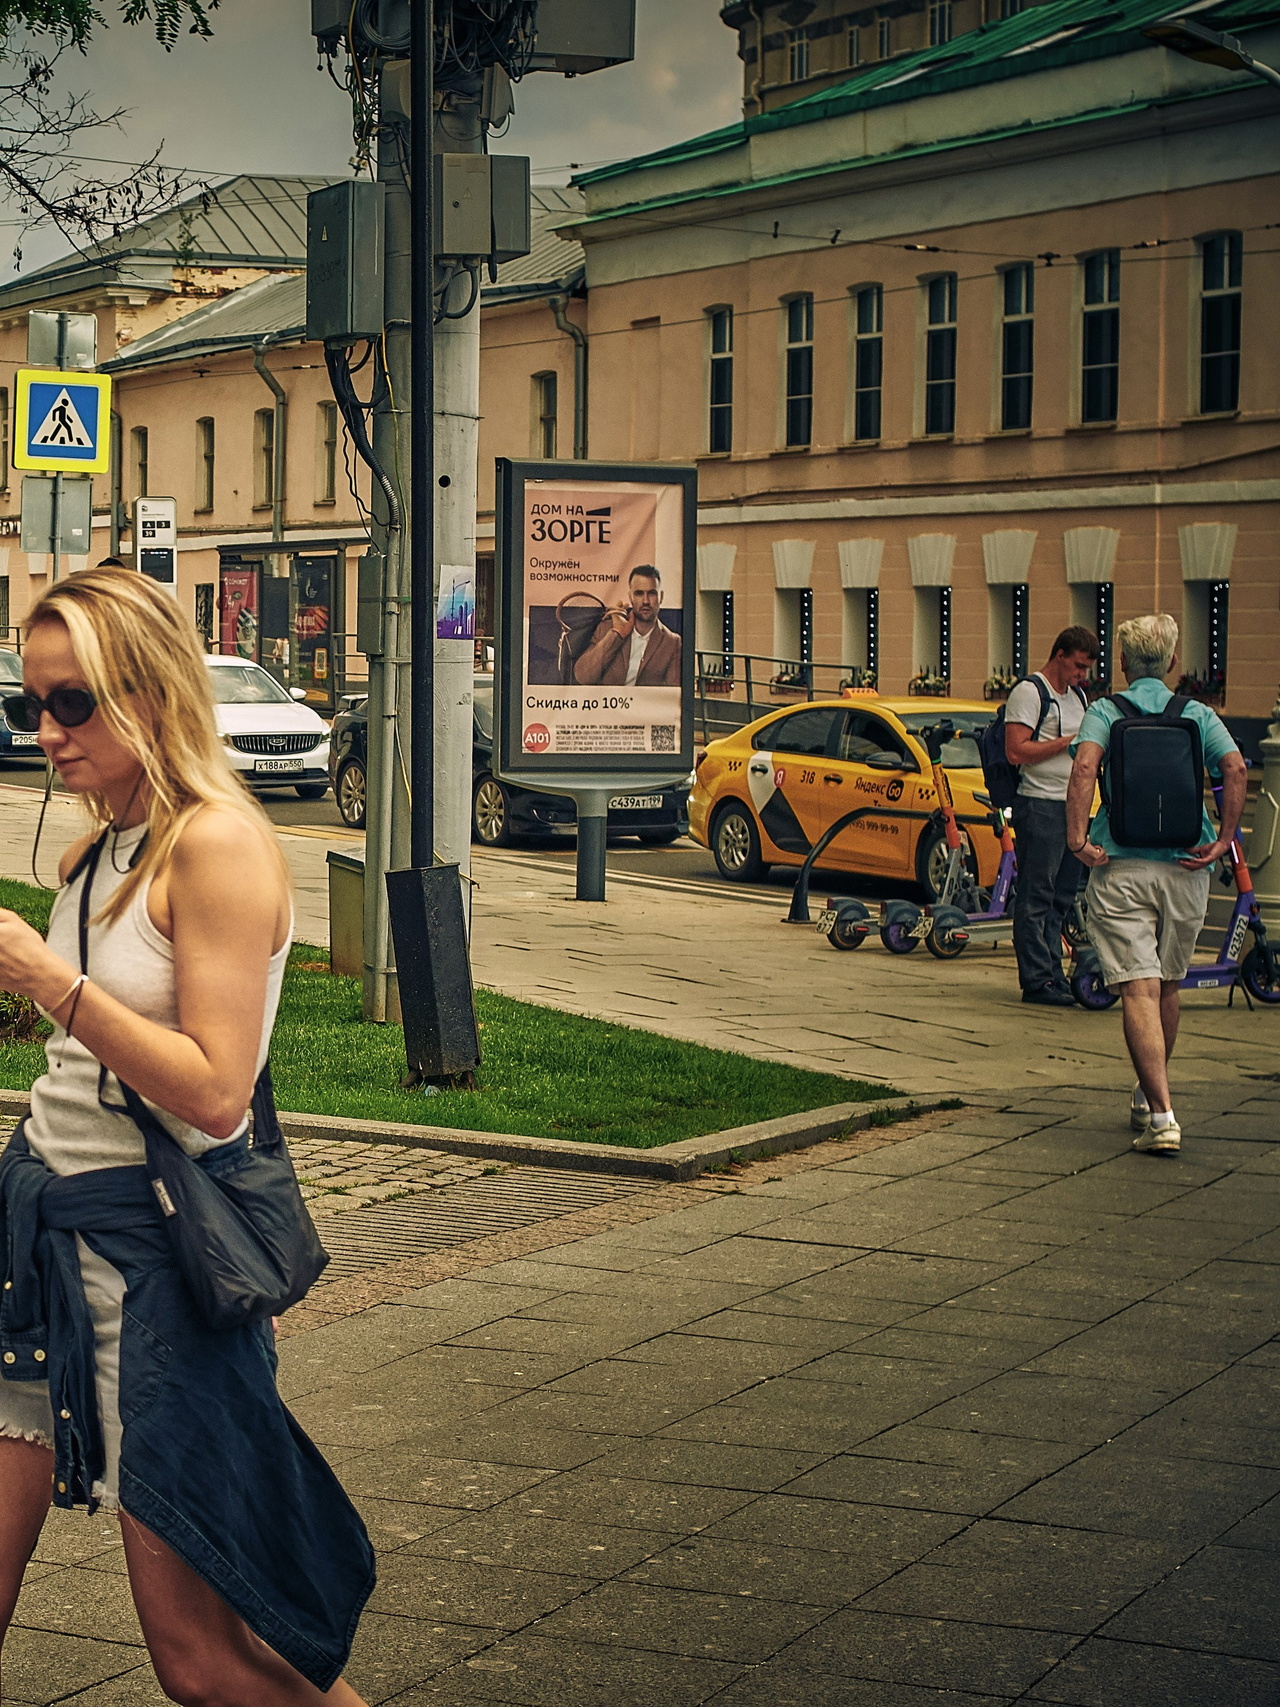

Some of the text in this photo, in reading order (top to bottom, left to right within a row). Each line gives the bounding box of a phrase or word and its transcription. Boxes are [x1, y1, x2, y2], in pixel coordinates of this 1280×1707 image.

[530, 503, 584, 516] ДОМ НА
[530, 518, 611, 544] ЗОРГЕ
[529, 557, 580, 571] Окружён
[529, 572, 620, 583] возможностями
[526, 695, 578, 710] Скидка
[581, 698, 599, 710] до
[800, 770, 816, 785] 318
[854, 777, 886, 795] Яндекс
[888, 780, 901, 798] Go
[1229, 918, 1248, 958] 423672
